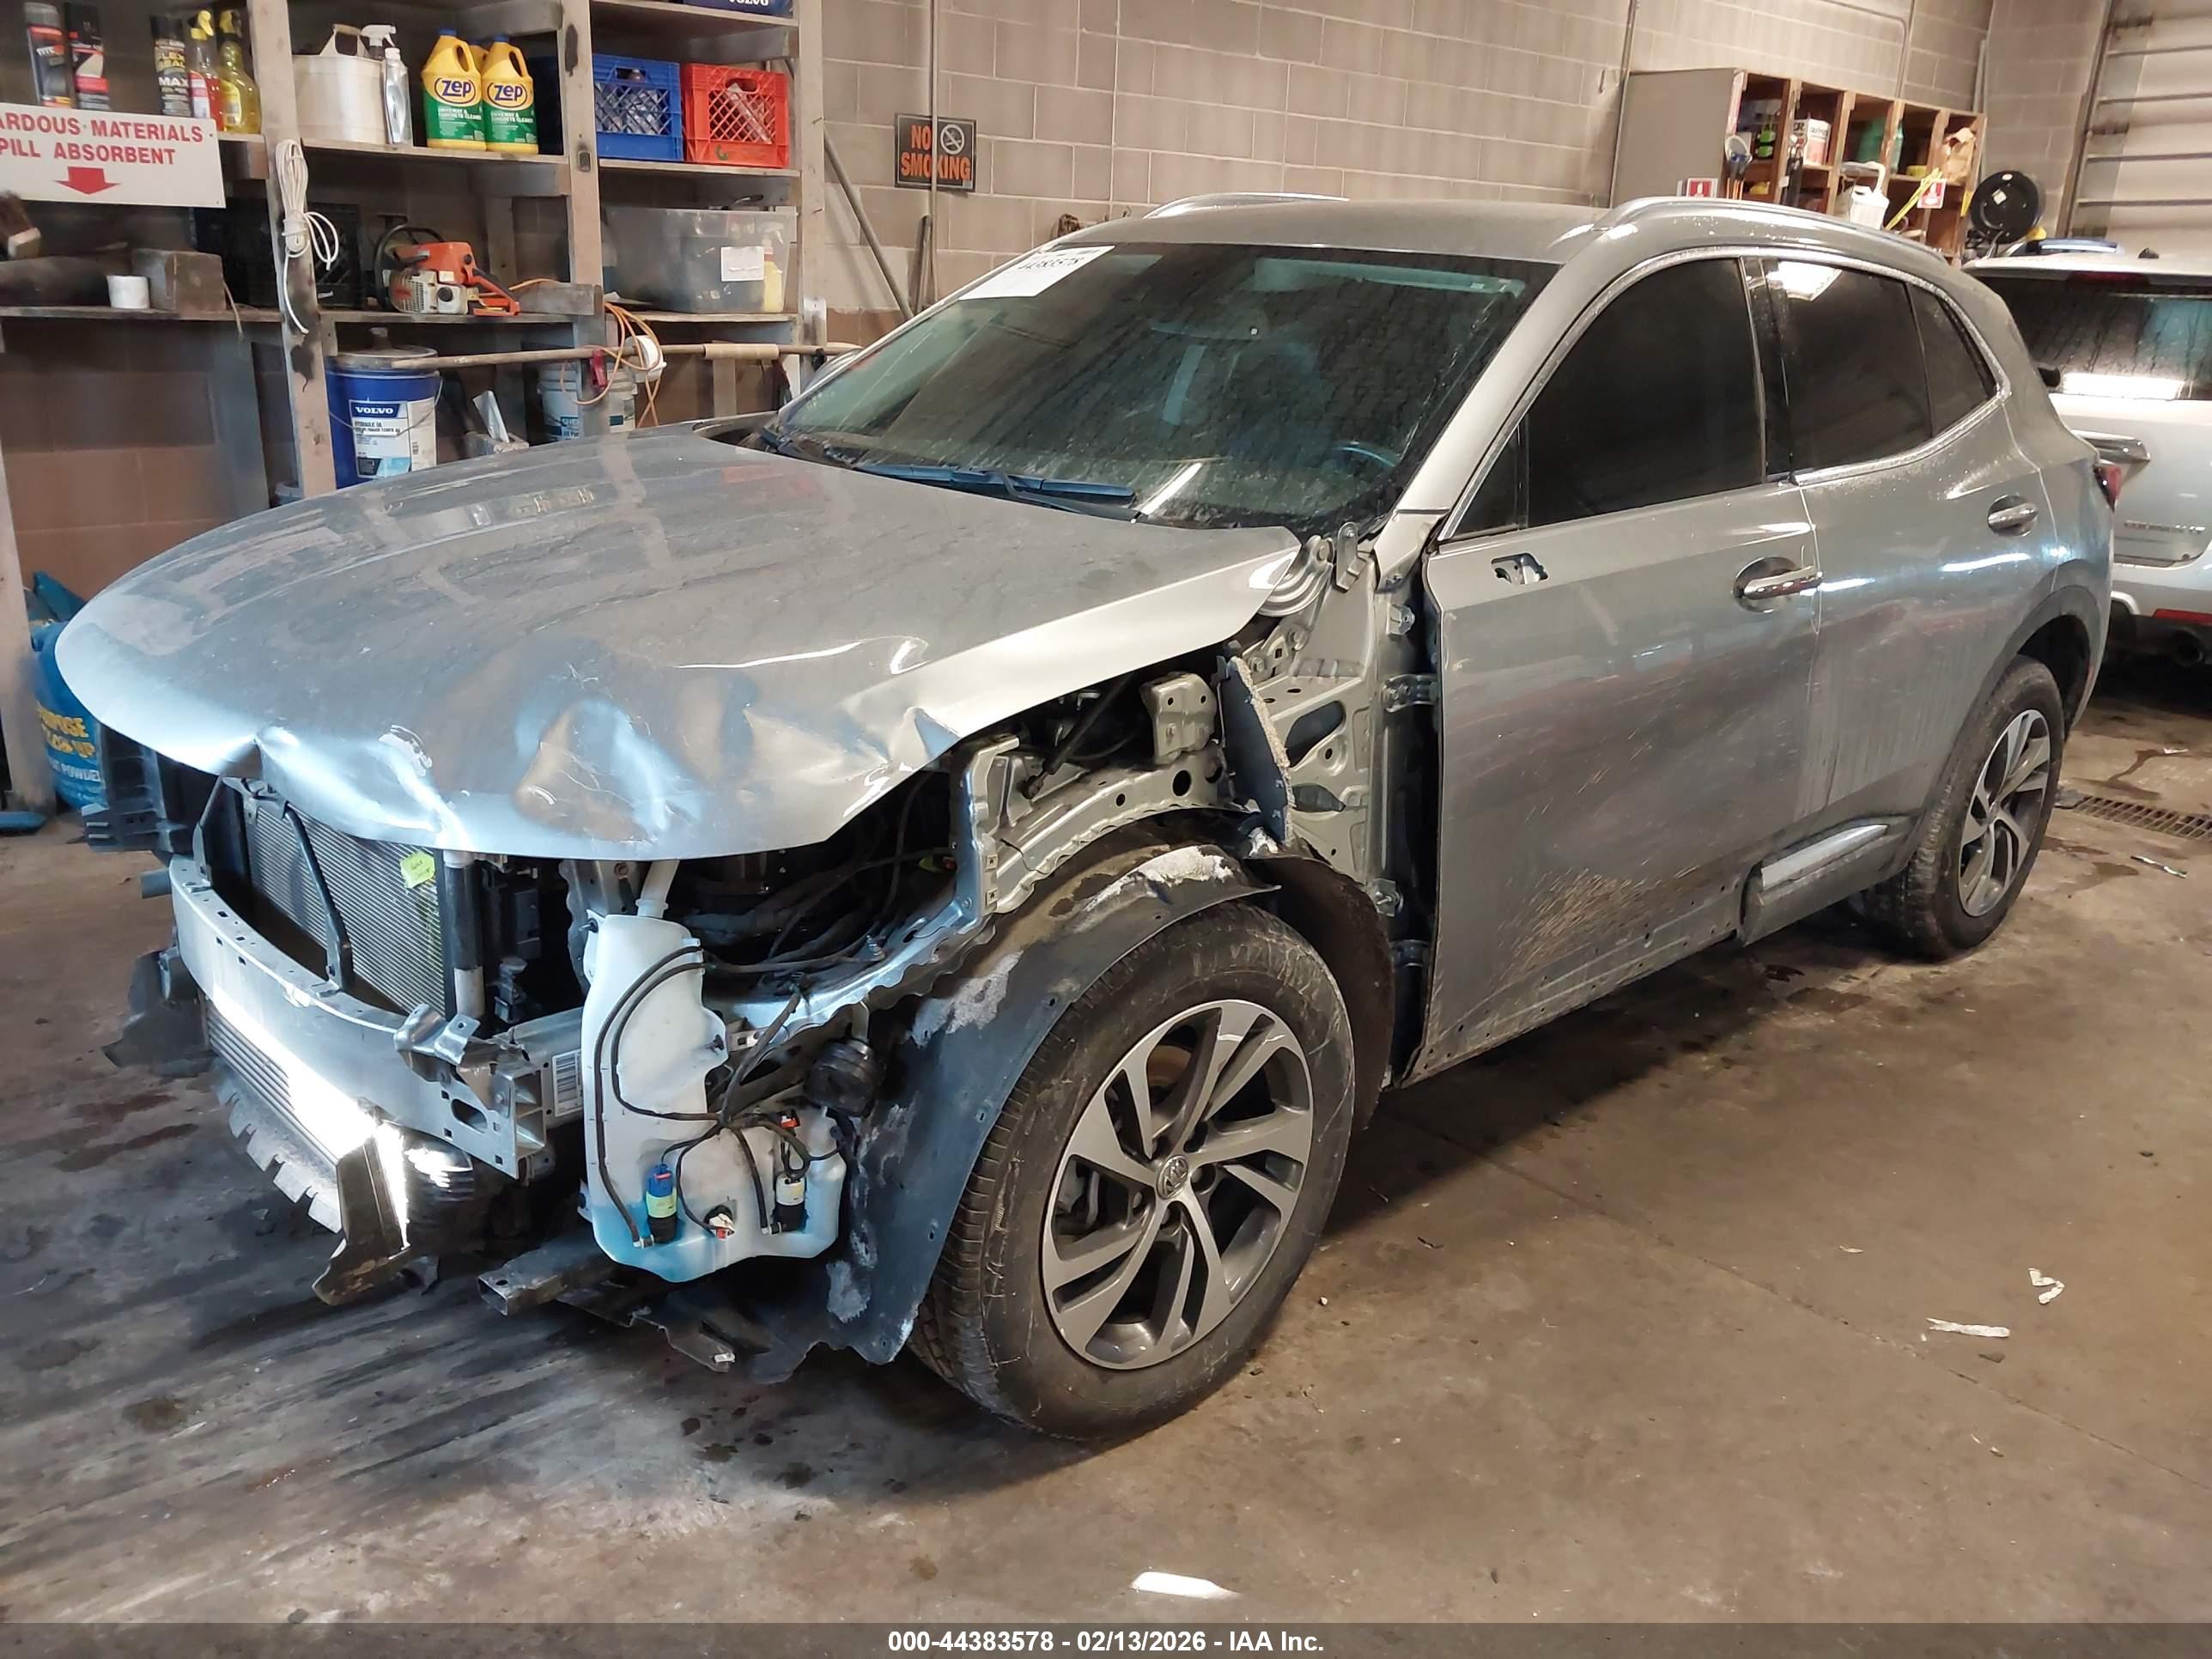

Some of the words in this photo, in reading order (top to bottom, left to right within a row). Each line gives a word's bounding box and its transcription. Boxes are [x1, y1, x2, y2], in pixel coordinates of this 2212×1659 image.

[90, 119, 204, 143] MATERIALS
[911, 124, 932, 151] NO
[53, 142, 176, 165] ABSORBENT
[900, 151, 971, 180] SMOKING
[355, 406, 394, 415] VOLVO
